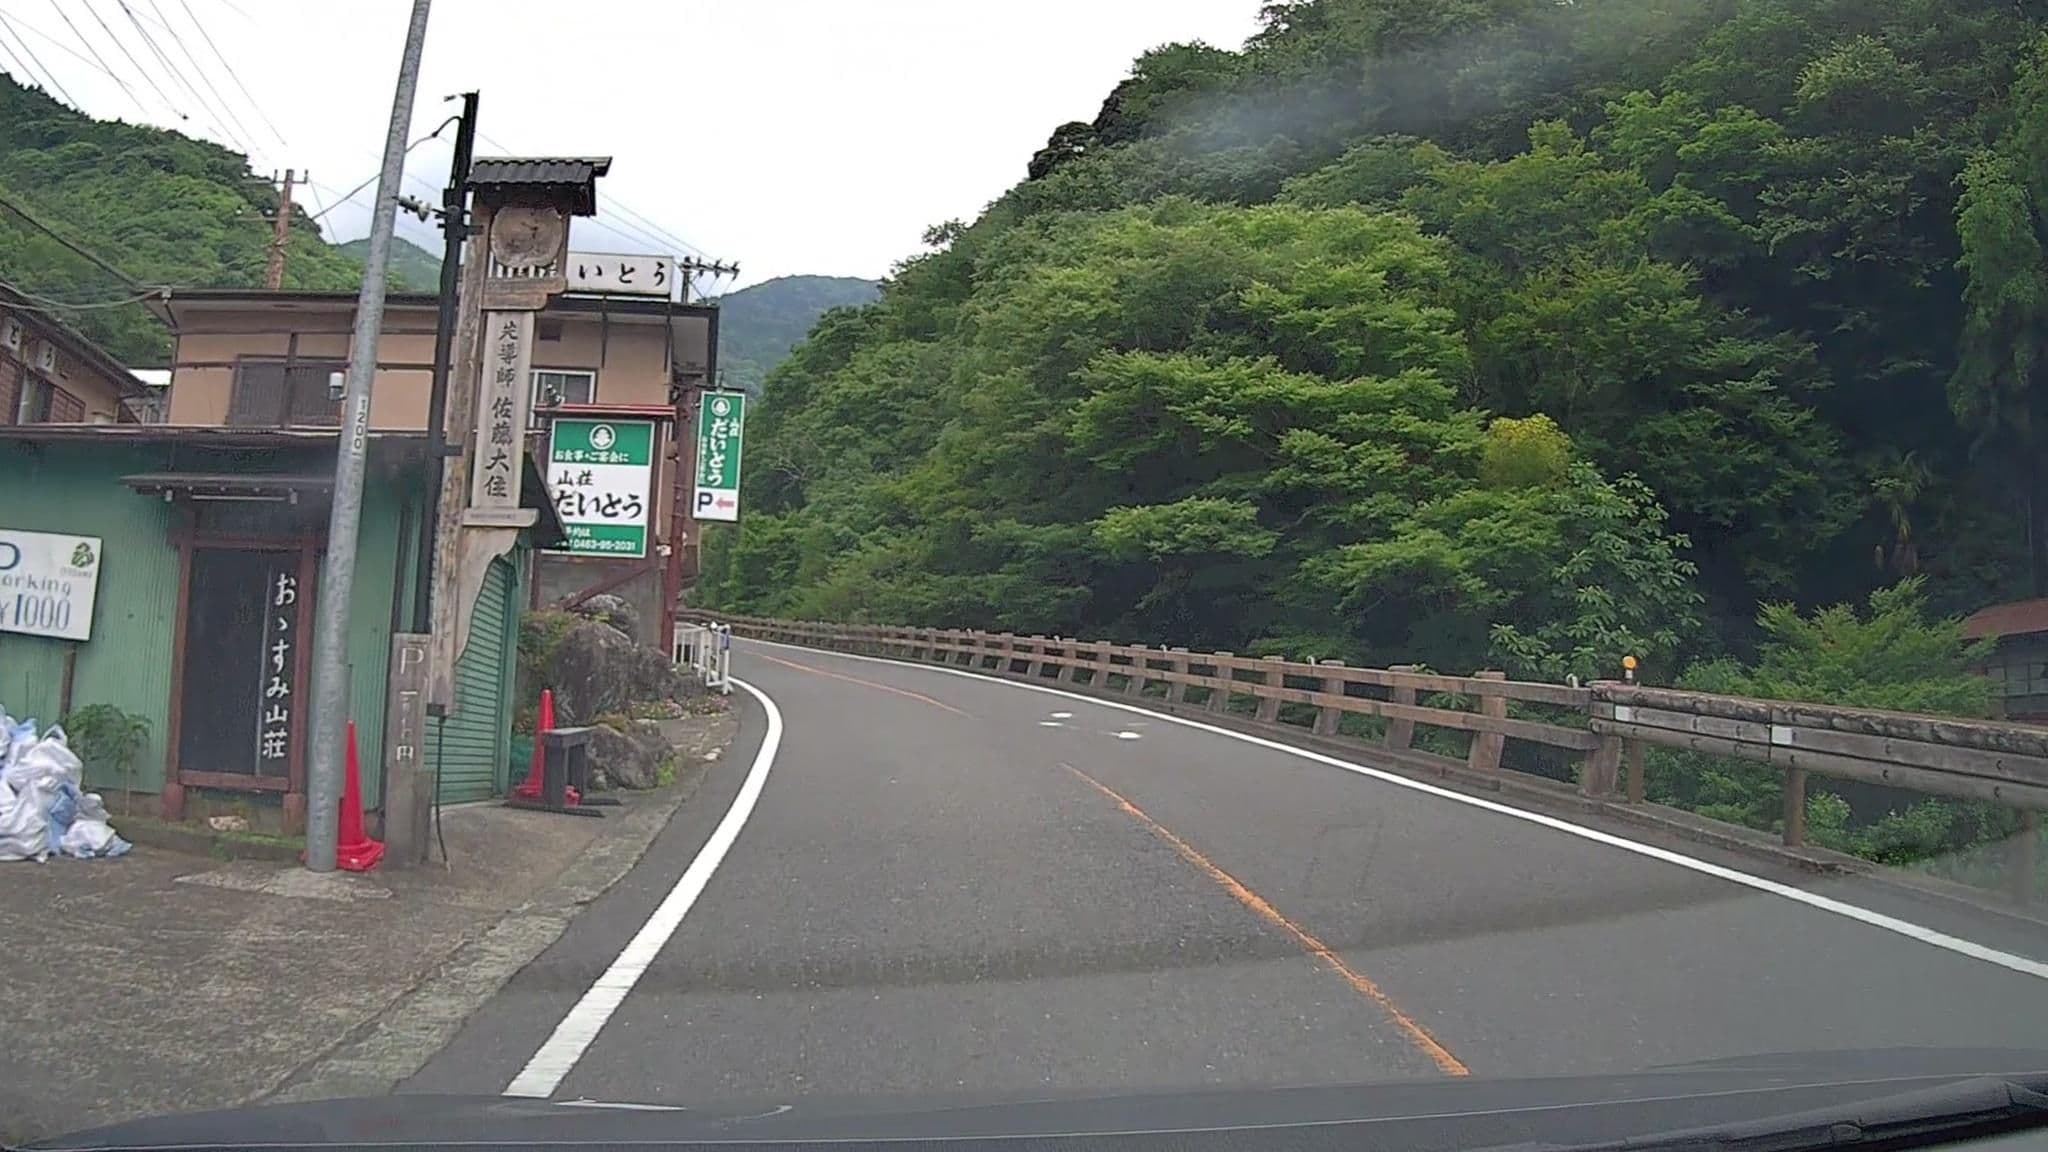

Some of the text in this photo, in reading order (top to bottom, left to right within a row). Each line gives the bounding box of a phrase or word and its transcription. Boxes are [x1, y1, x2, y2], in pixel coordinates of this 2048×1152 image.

[579, 262, 665, 287] いとう
[354, 399, 366, 449] 1200
[707, 418, 729, 487] だいとう
[557, 469, 594, 486] 山荘
[557, 489, 642, 518] だいとう
[698, 492, 713, 512] P
[0, 573, 71, 597] arking
